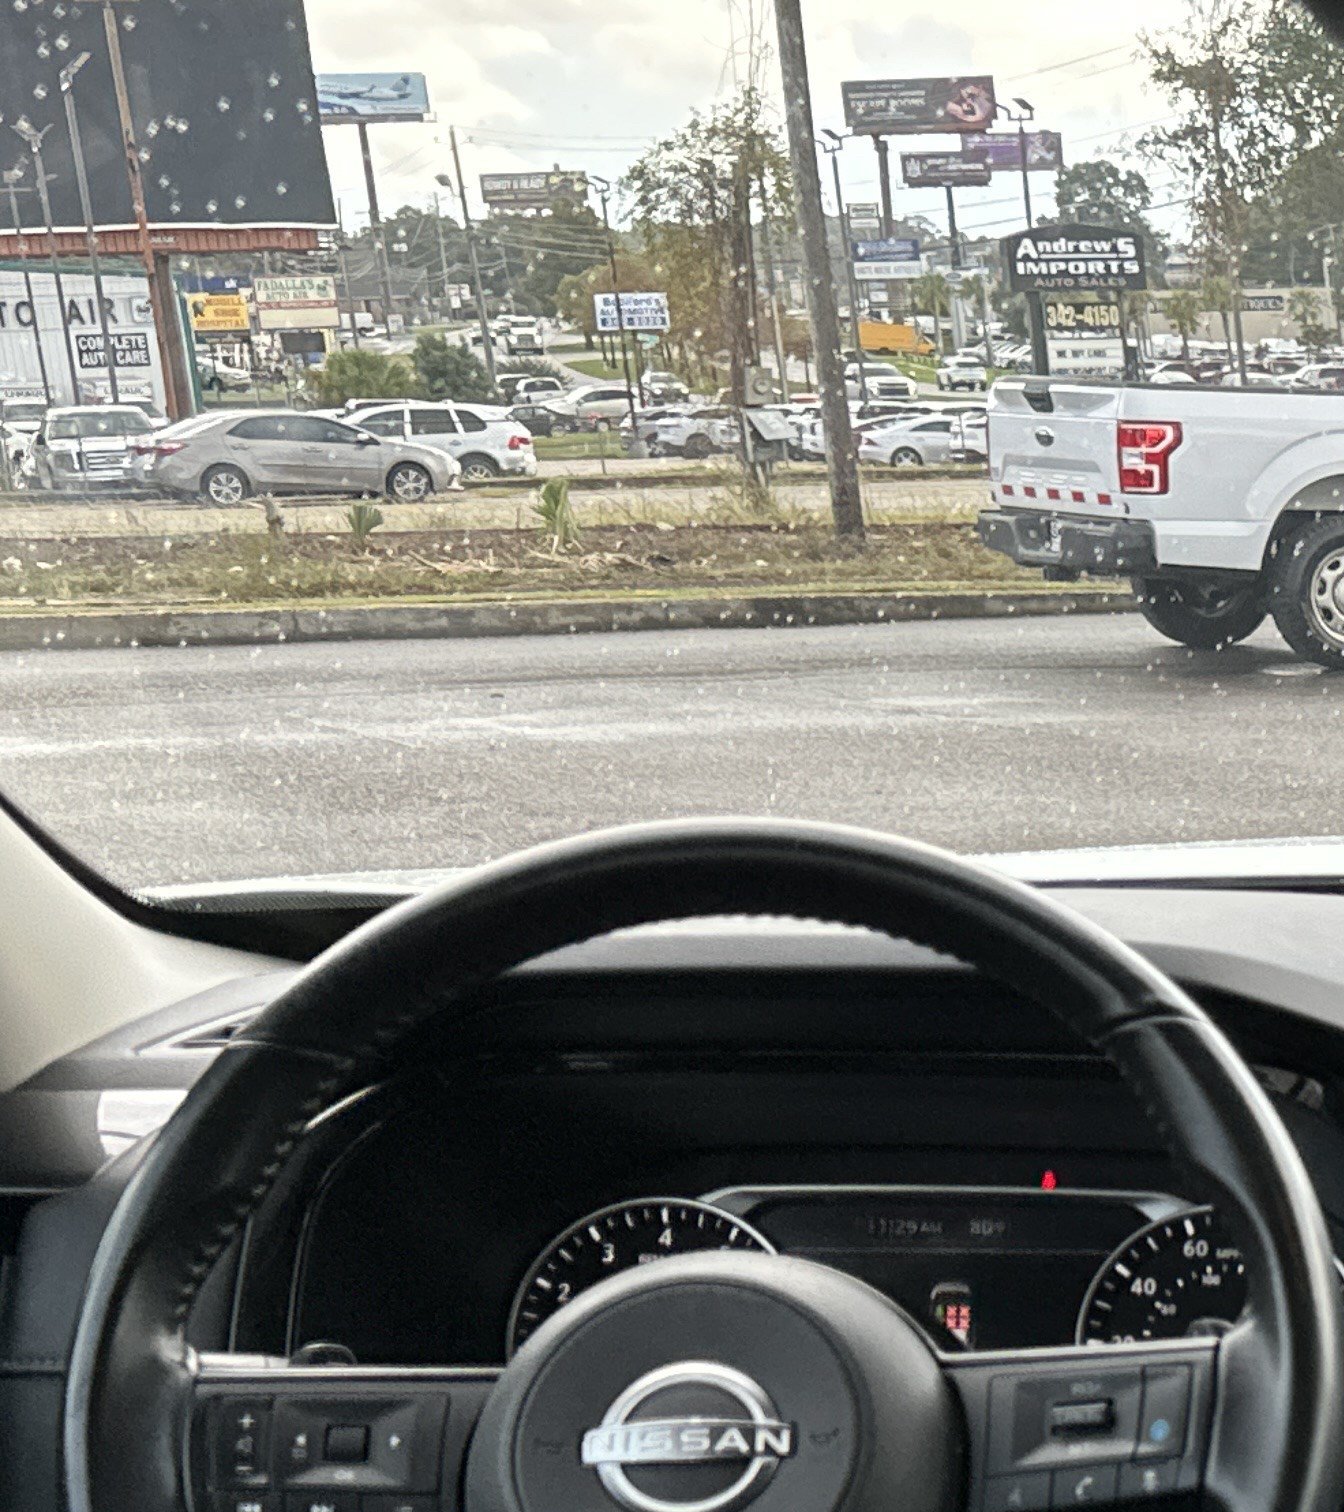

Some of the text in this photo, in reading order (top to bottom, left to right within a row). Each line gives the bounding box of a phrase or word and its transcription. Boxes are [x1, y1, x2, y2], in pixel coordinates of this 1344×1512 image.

[1016, 260, 1140, 275] IMPORTS
[1034, 278, 1075, 288] AUTO
[67, 297, 118, 325] AIR
[1046, 303, 1119, 327] 342-4150
[115, 350, 149, 364] CARE
[658, 1226, 673, 1248] 4
[602, 1242, 616, 1264] 3
[1182, 1239, 1209, 1259] 60
[556, 1282, 571, 1302] 2
[1130, 1276, 1157, 1297] 40
[588, 1426, 792, 1458] NISSAN
